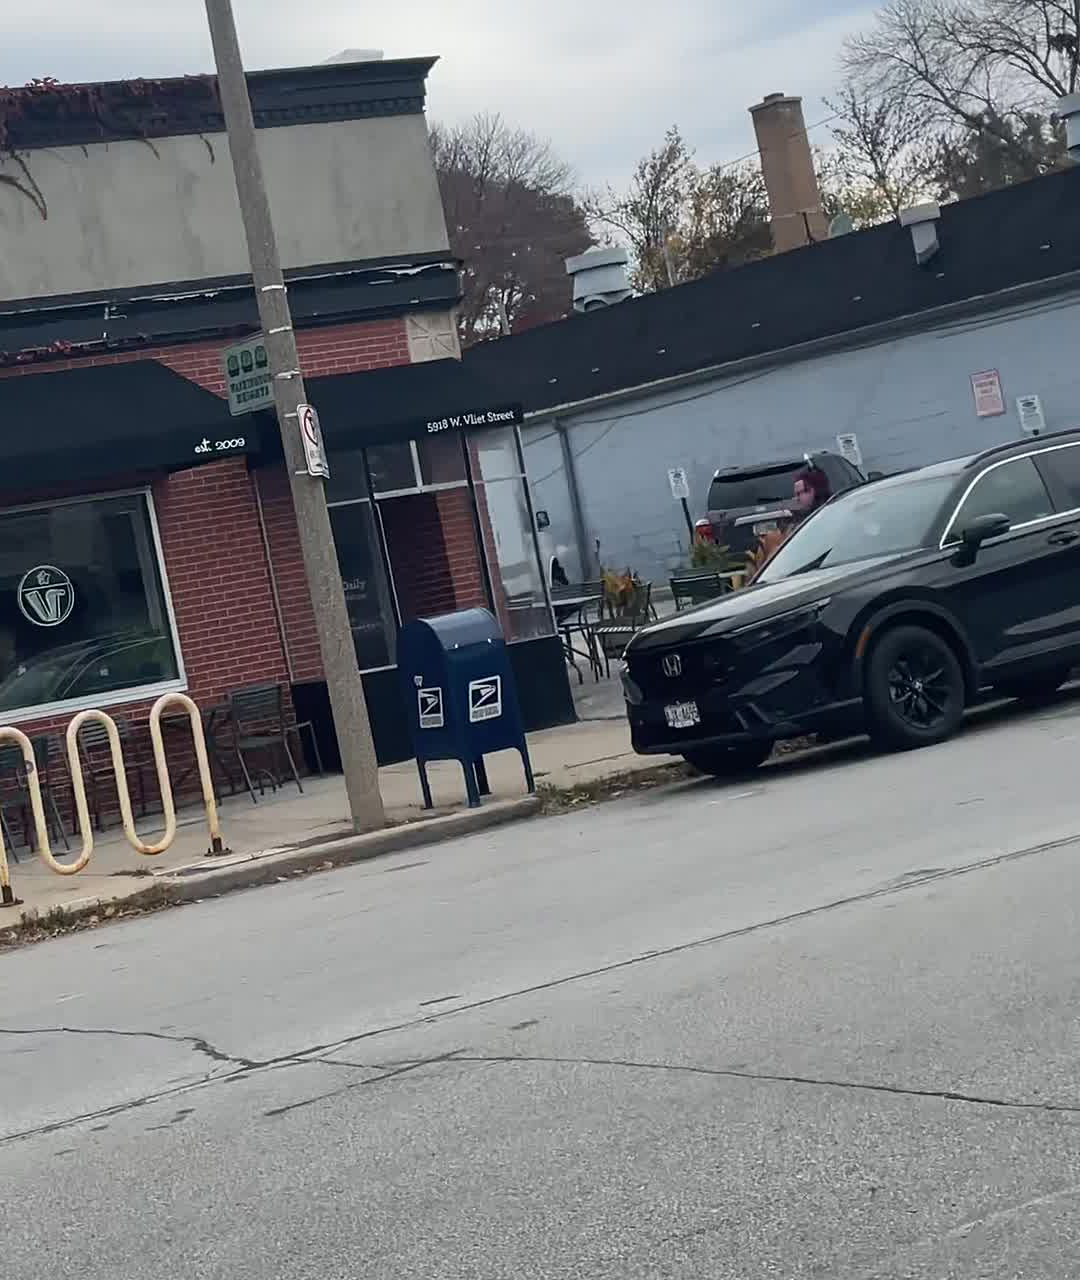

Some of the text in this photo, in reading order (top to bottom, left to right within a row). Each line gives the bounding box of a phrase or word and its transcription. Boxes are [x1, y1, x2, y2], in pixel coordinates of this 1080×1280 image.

[427, 411, 514, 432] 5918 W. Vliet Street
[194, 437, 245, 453] est. 2009
